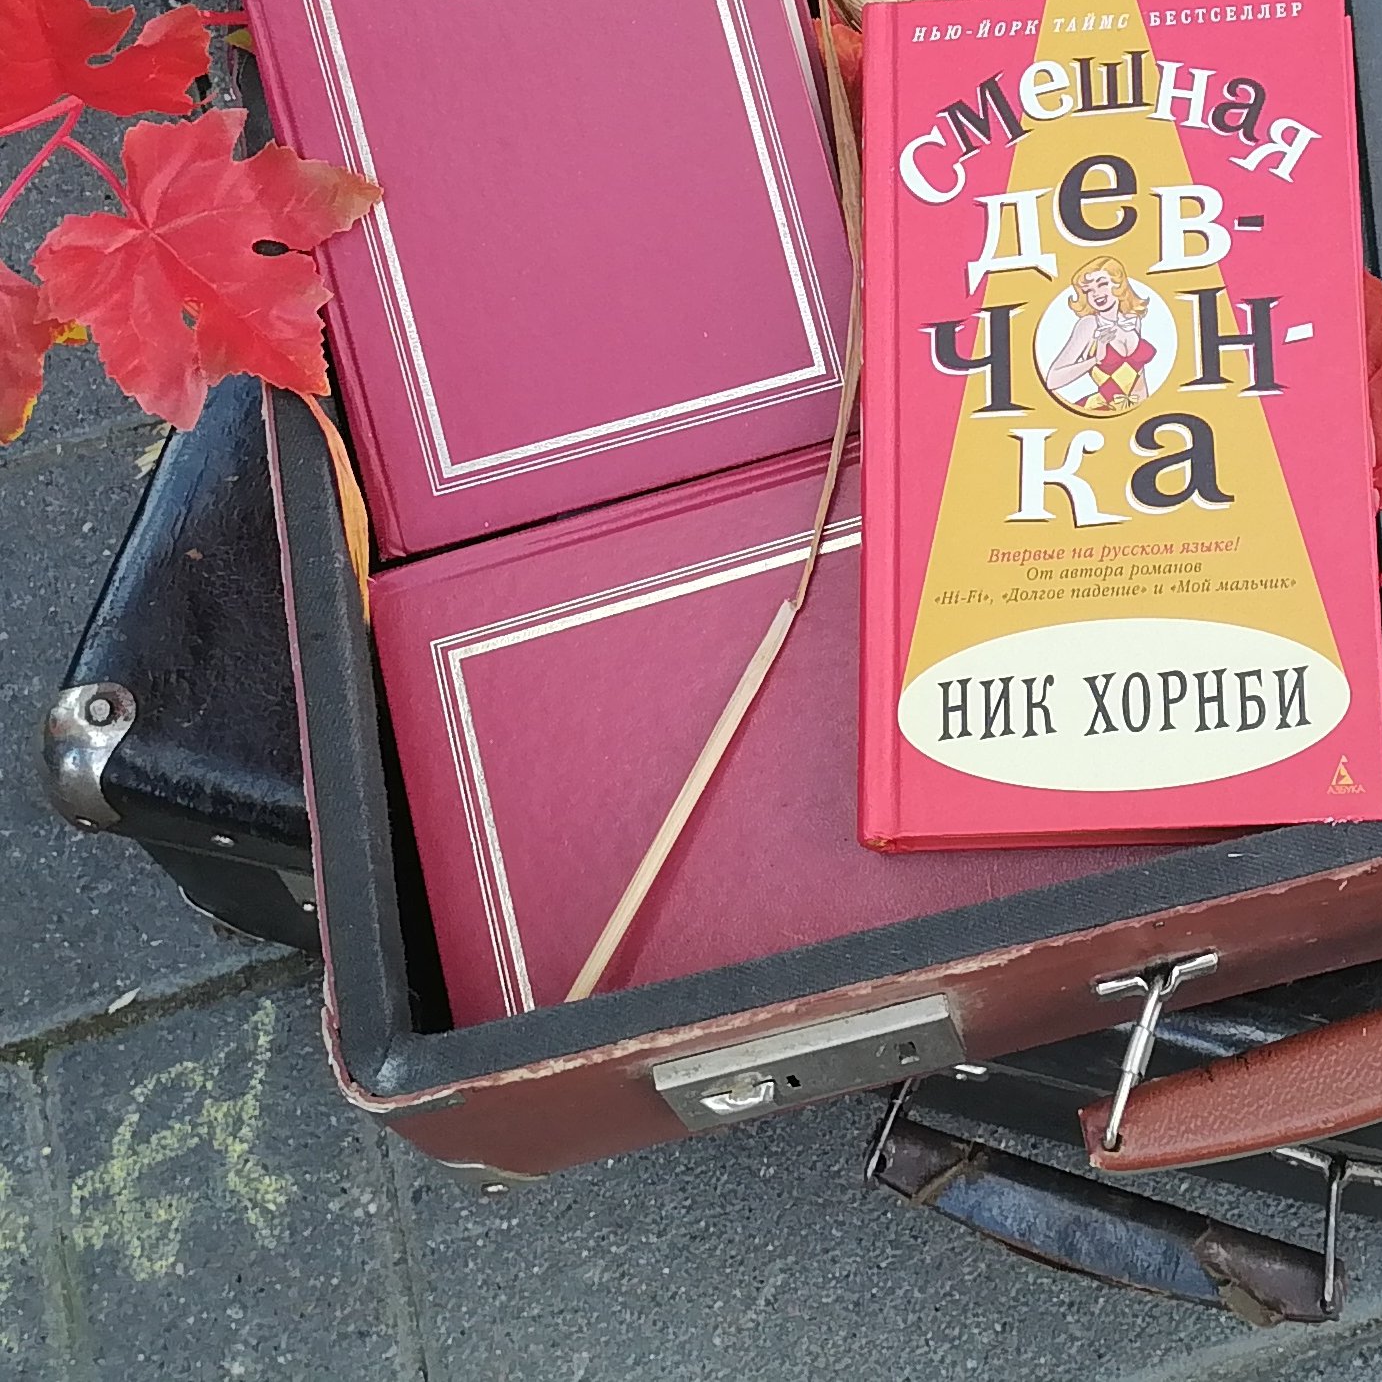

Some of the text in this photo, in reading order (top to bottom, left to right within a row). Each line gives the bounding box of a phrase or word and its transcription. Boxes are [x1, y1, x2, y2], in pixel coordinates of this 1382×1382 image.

[912, 1, 1305, 43] НЬЮ-ЙОРК ТАЙМС БЕСТСЕЛЛЕР
[986, 536, 1242, 568] Впервые на русском языке!
[1025, 561, 1203, 584] От автора романов
[1152, 584, 1164, 595] и
[1169, 576, 1211, 594] «Мой
[1215, 576, 1298, 593] мальчик»
[937, 664, 1313, 742] НИК ХОРНБИ
